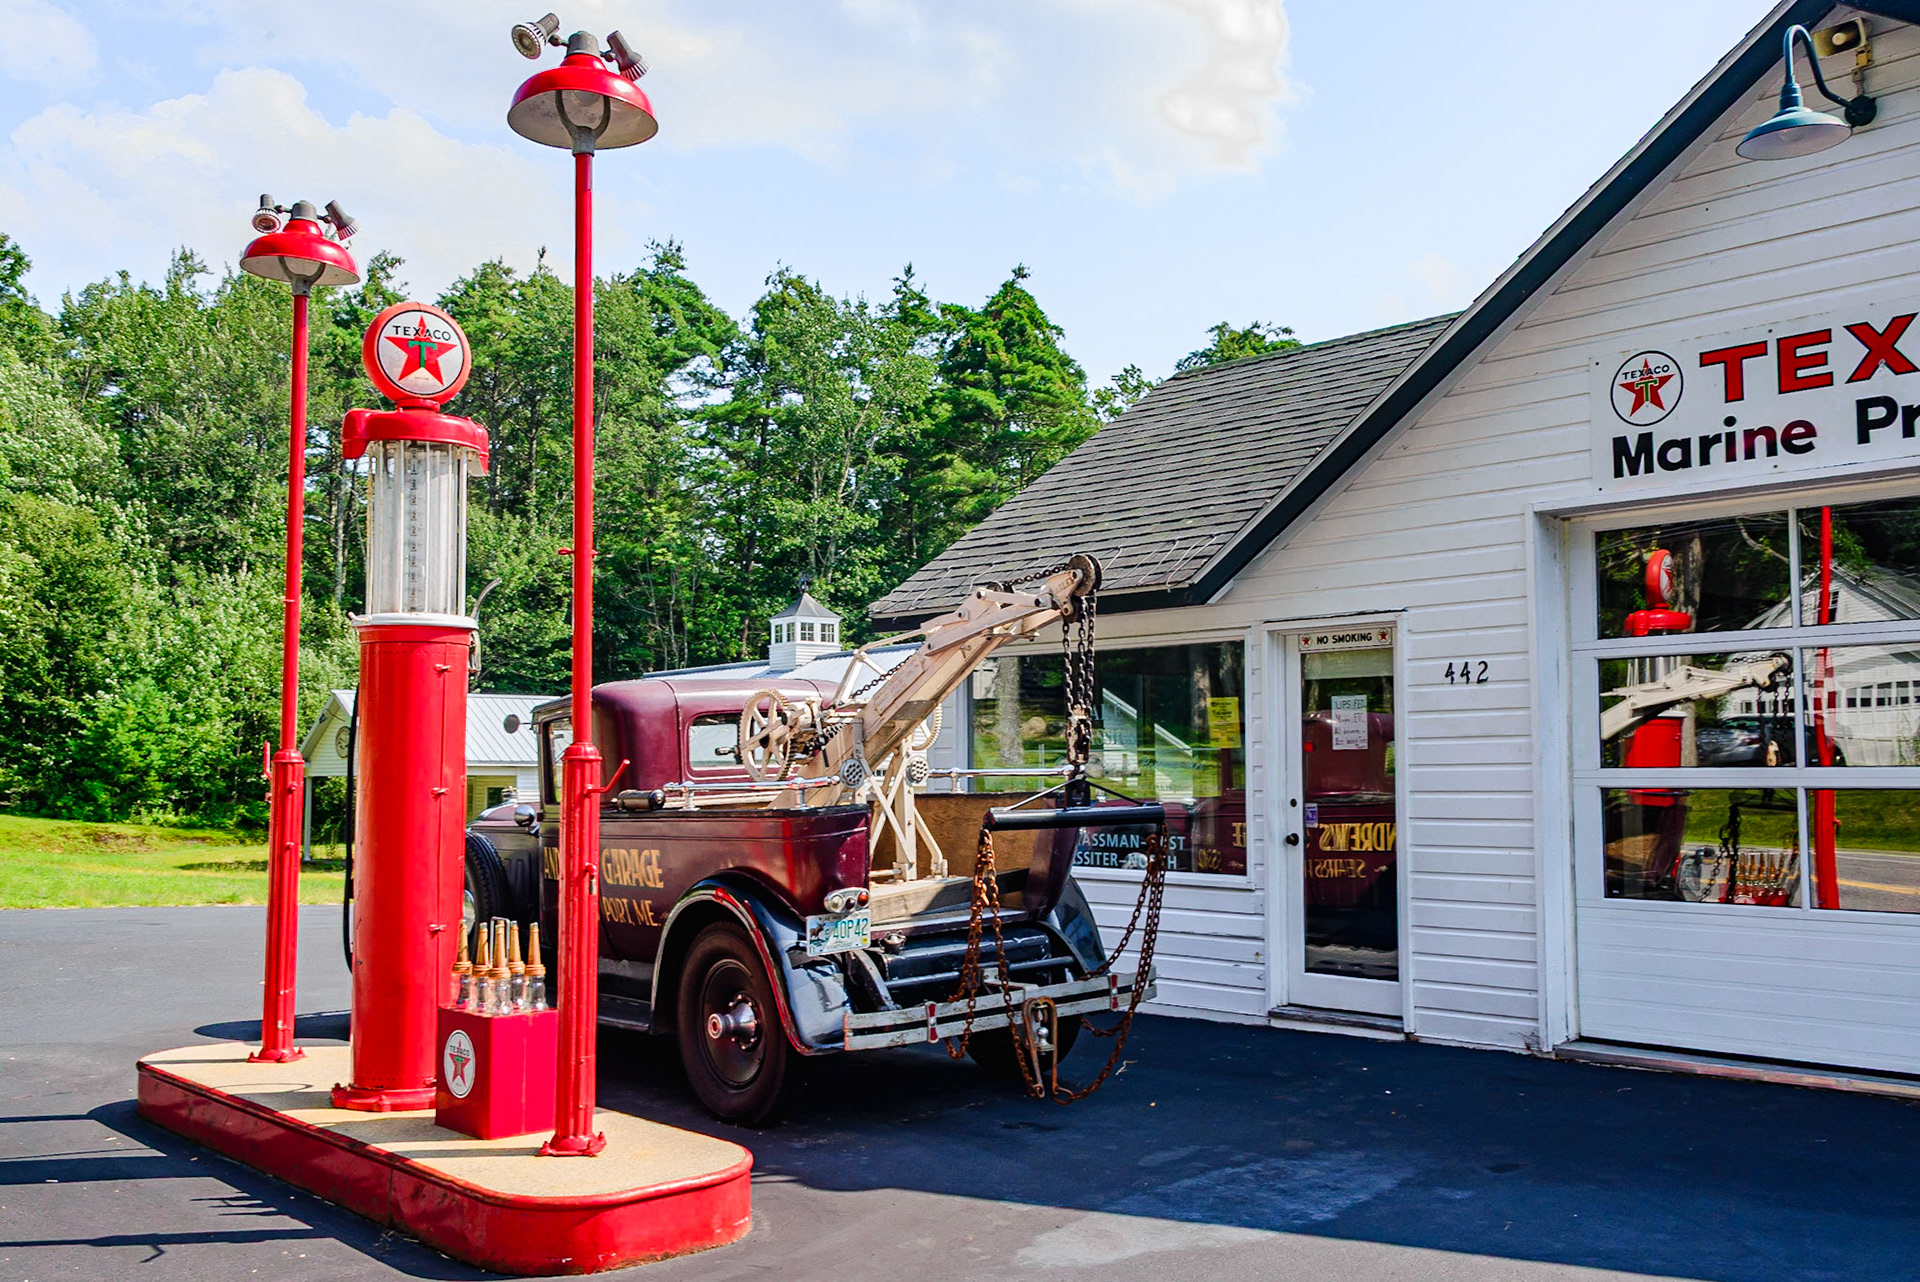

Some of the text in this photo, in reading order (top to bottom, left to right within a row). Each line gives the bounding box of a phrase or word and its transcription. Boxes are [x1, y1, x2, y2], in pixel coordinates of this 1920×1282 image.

[393, 325, 451, 341] TEXACO
[1699, 312, 1920, 403] TEX
[1622, 364, 1670, 380] TEXACO
[1612, 415, 1818, 479] Marine
[1316, 632, 1373, 645] NO SMOKING
[1444, 660, 1489, 685] 442
[602, 849, 664, 888] GARAGE
[450, 1045, 470, 1057] TEXACO
